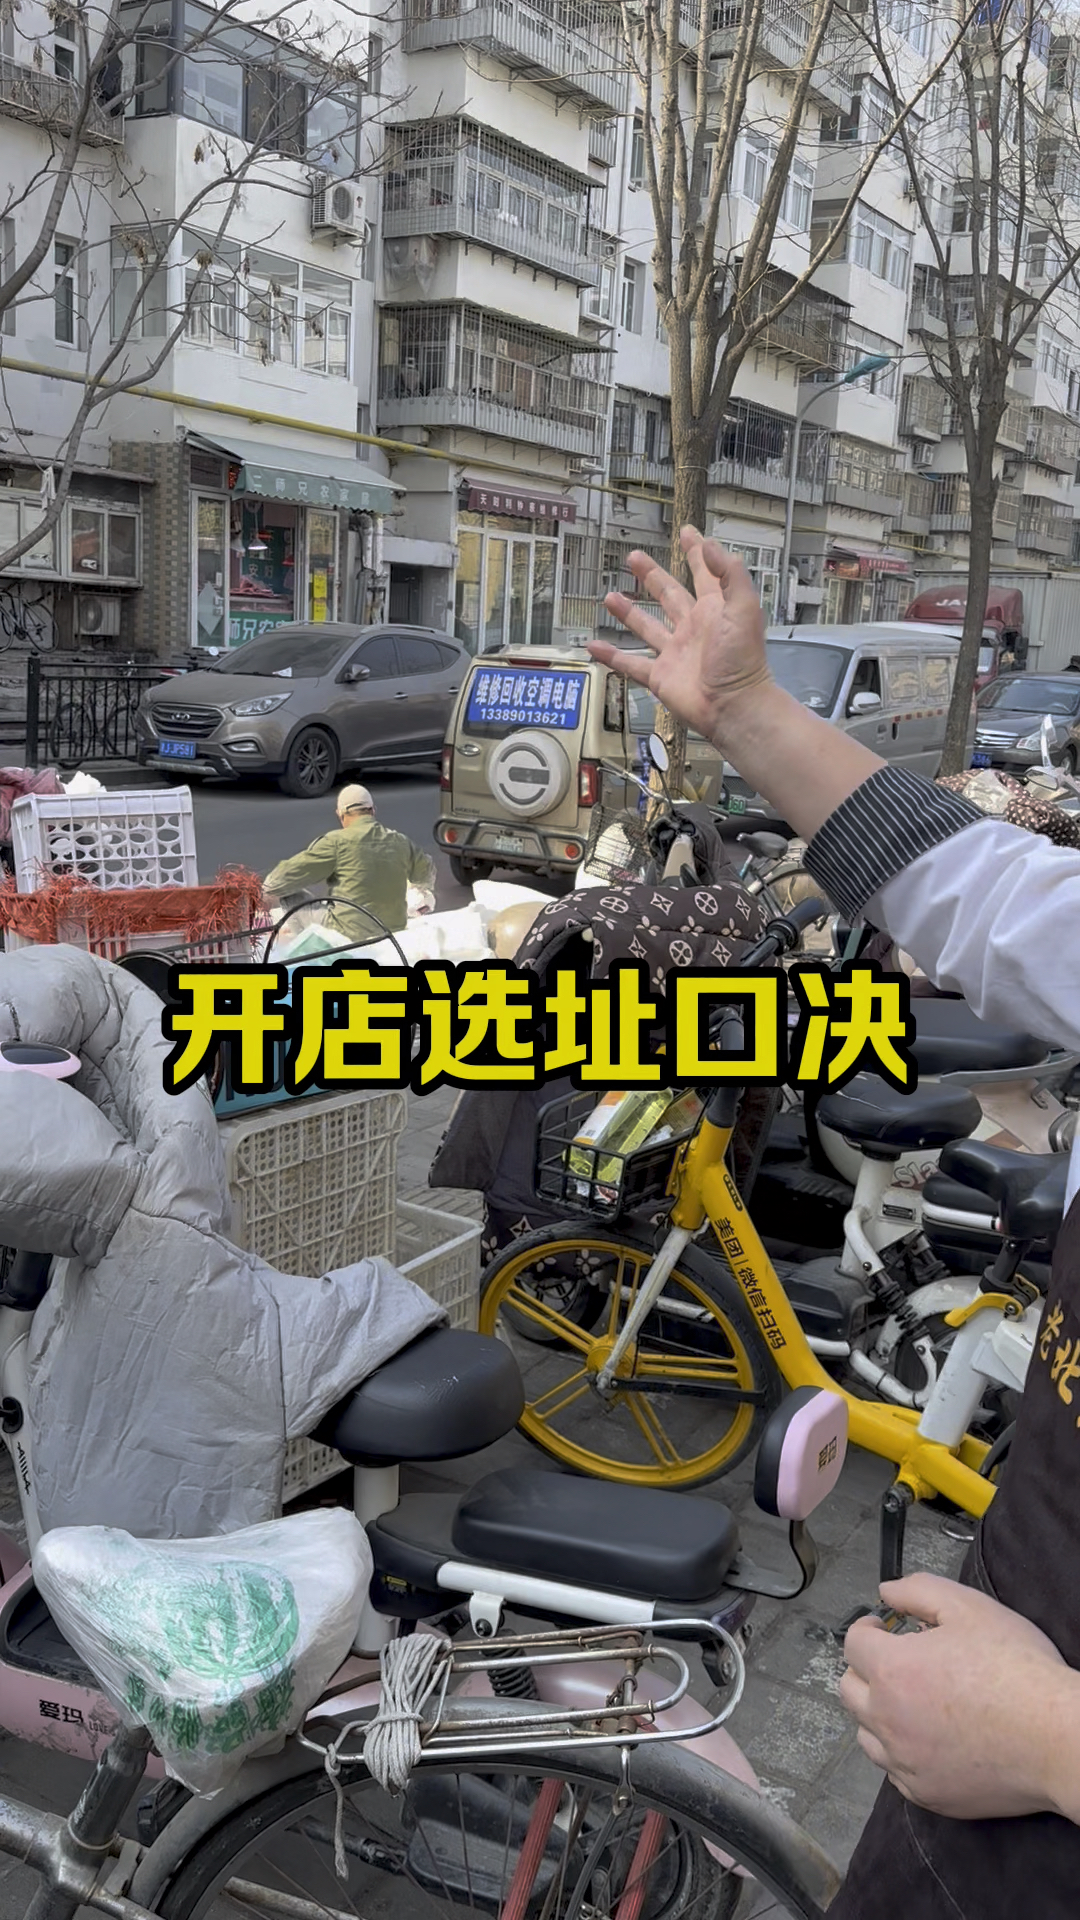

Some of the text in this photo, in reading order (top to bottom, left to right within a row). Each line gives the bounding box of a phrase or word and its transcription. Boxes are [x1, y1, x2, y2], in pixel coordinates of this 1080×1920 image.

[935, 598, 968, 607] JA
[230, 618, 286, 640] 师兄农
[475, 674, 581, 711] 维修回收空调电脑
[480, 708, 567, 725] 13389013621
[38, 1698, 85, 1724] 爱玛
